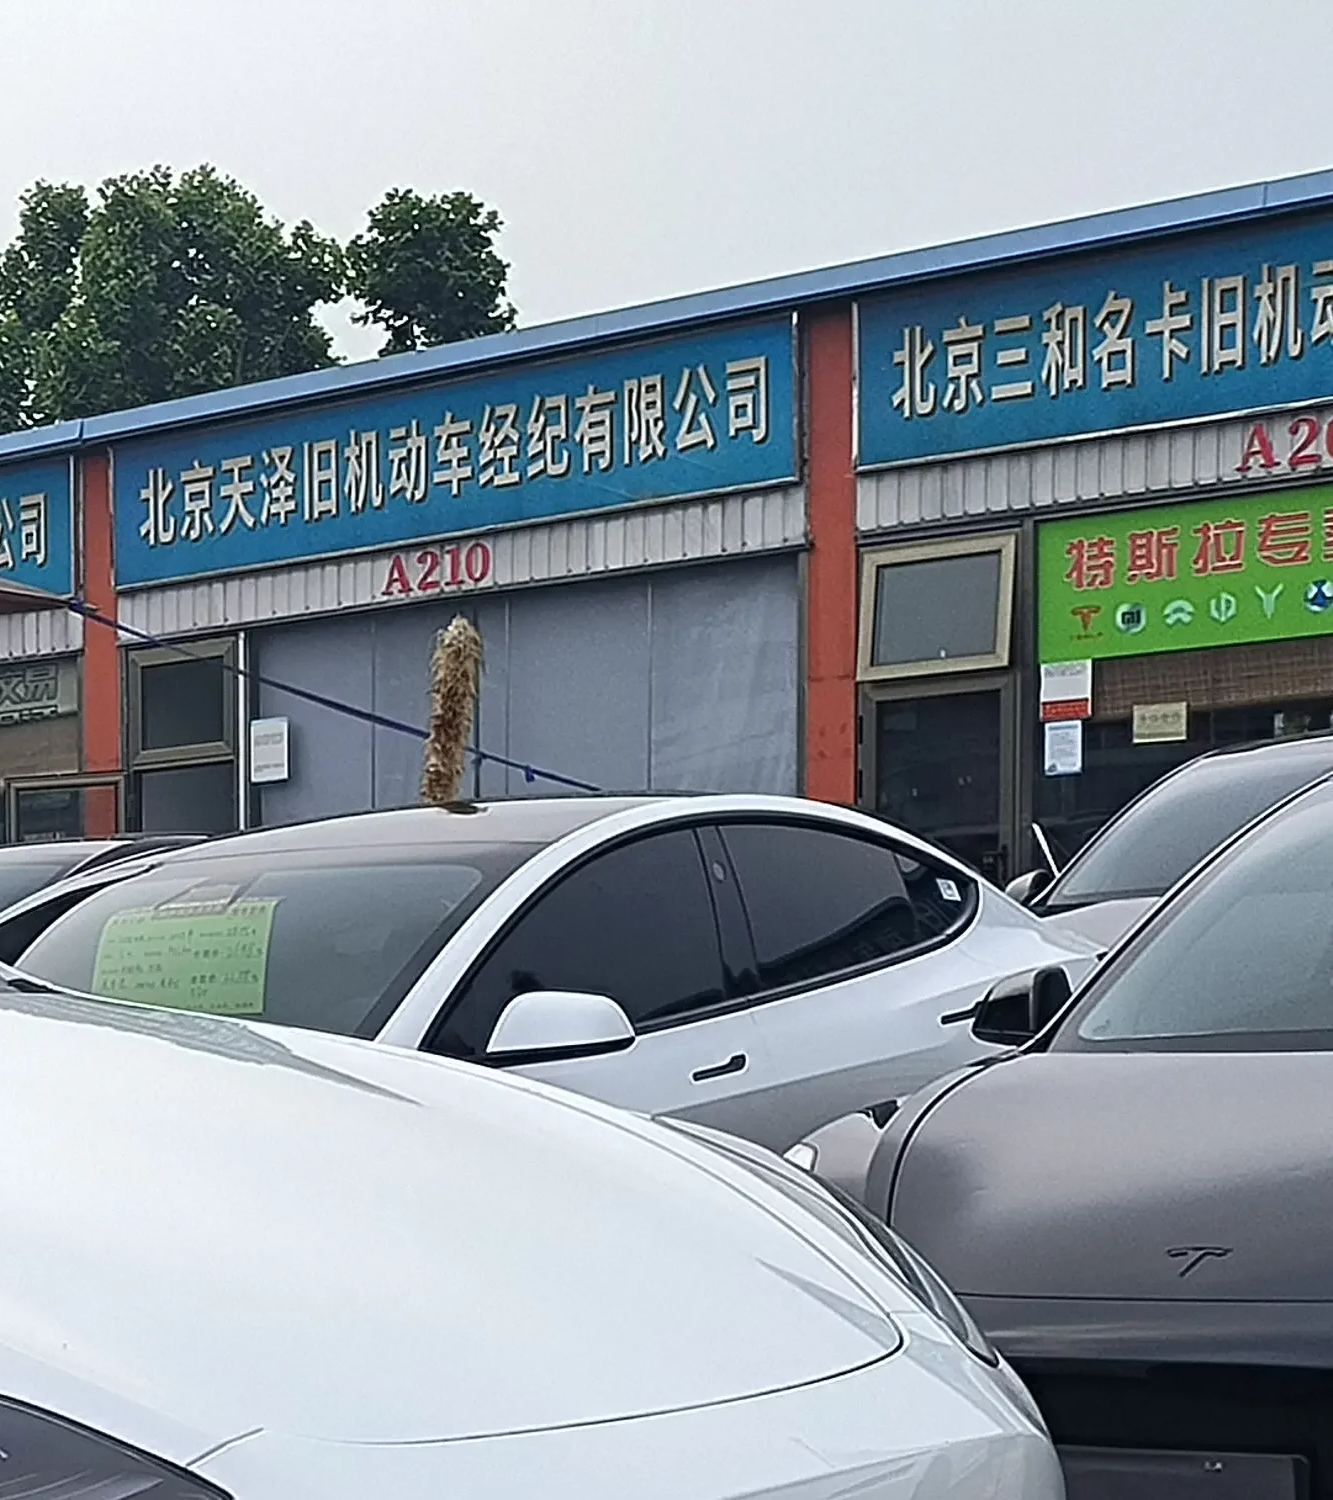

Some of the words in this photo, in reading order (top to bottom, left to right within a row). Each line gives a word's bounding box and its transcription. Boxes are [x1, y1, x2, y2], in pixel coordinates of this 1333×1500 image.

[138, 353, 772, 548] 北京天泽旧机动车经纪有限公司
[382, 540, 491, 597] A210
[1064, 508, 1333, 591] 特斯拉专
